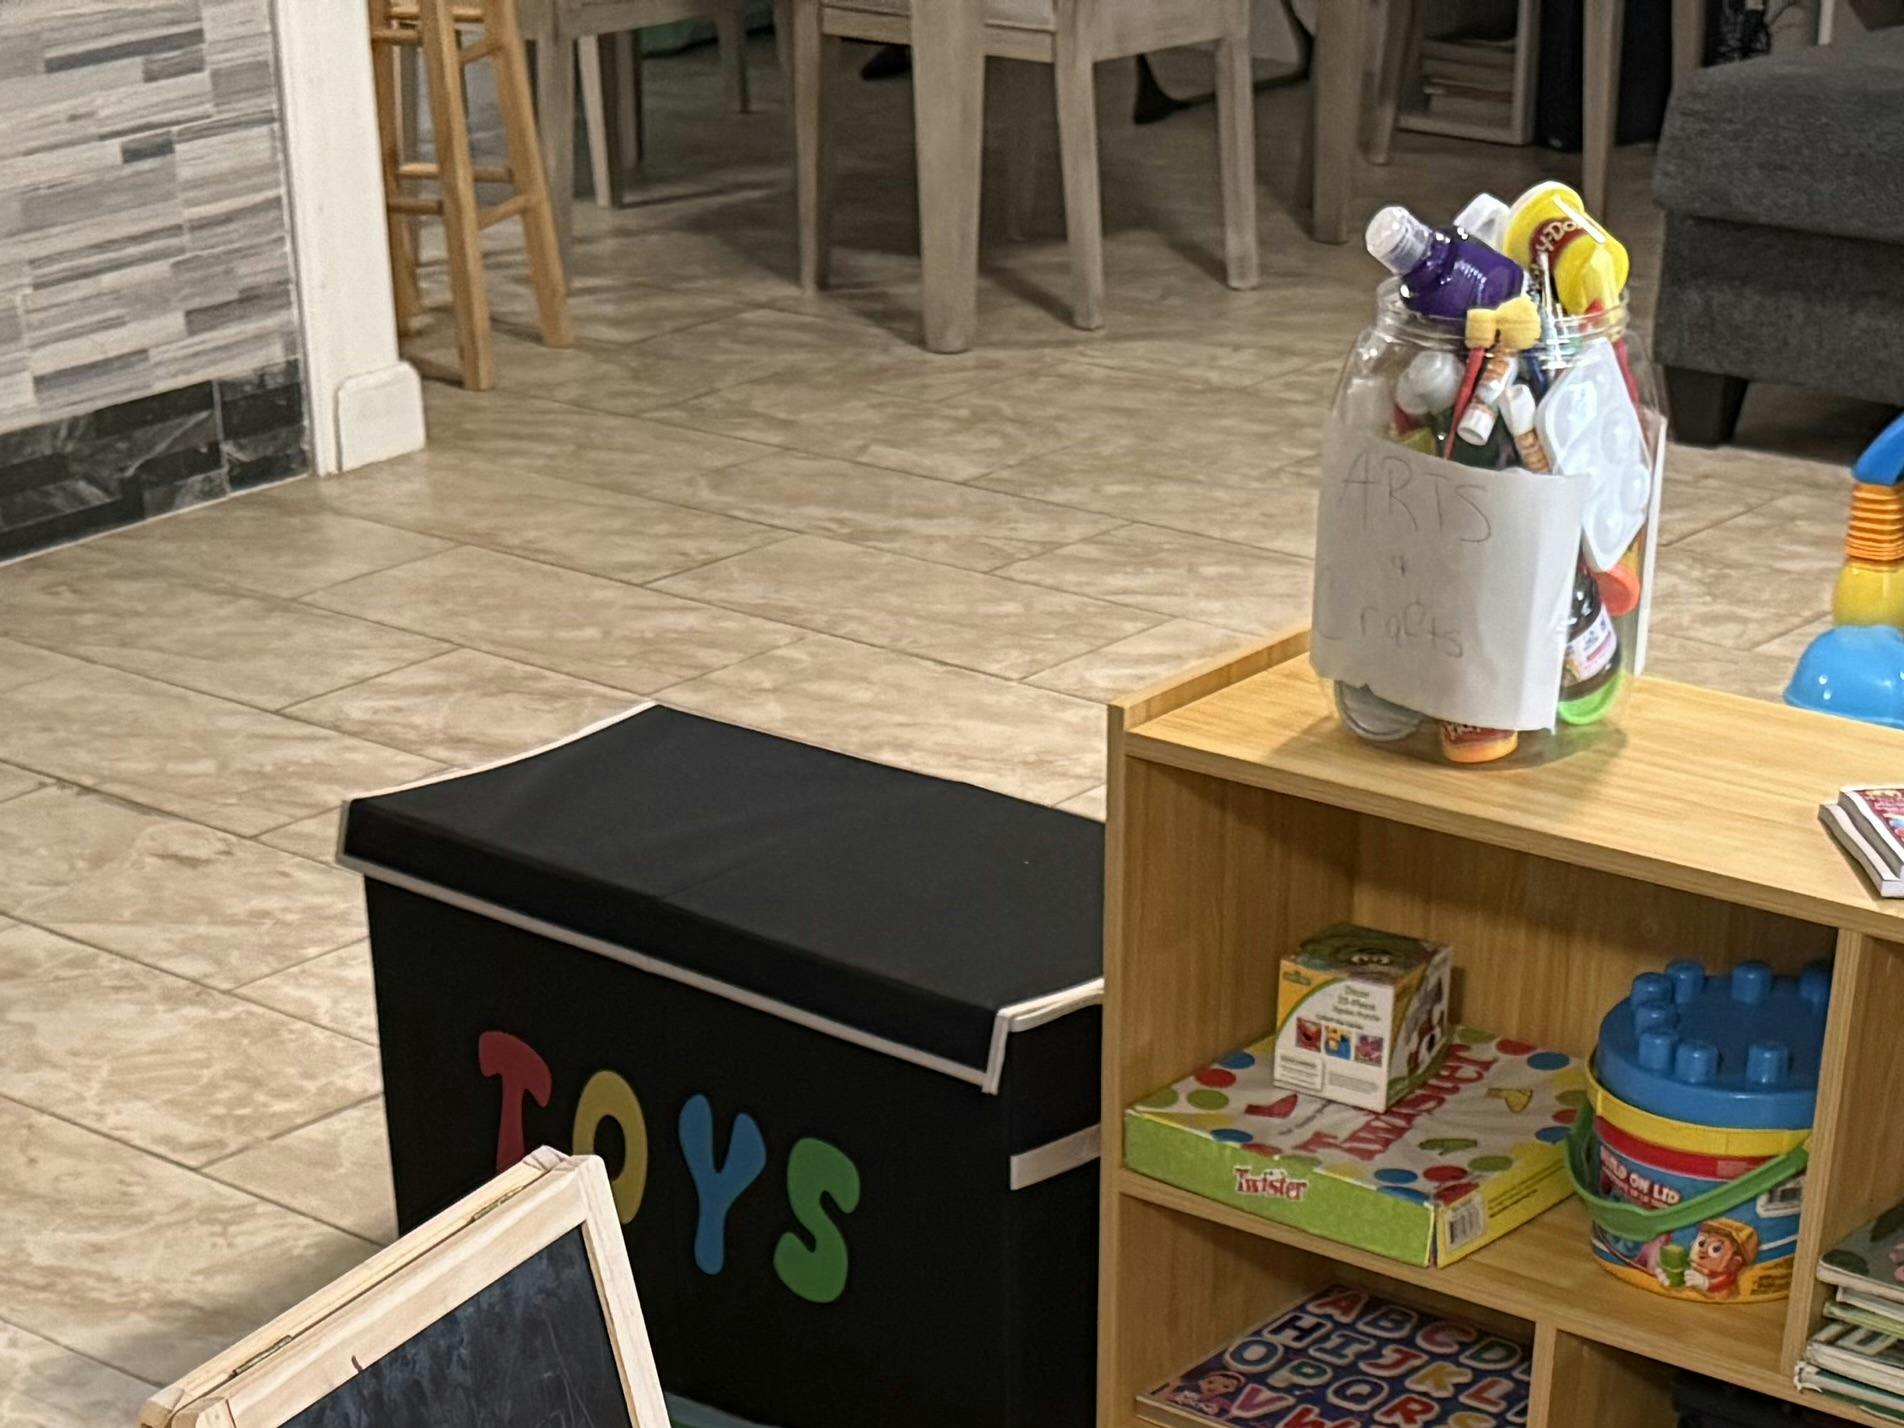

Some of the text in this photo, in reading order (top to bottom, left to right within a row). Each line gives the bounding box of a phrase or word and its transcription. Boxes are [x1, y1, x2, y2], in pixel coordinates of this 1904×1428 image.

[1343, 448, 1492, 543] ARTS
[477, 1029, 861, 1305] TOYS
[1234, 1166, 1309, 1201] Twister
